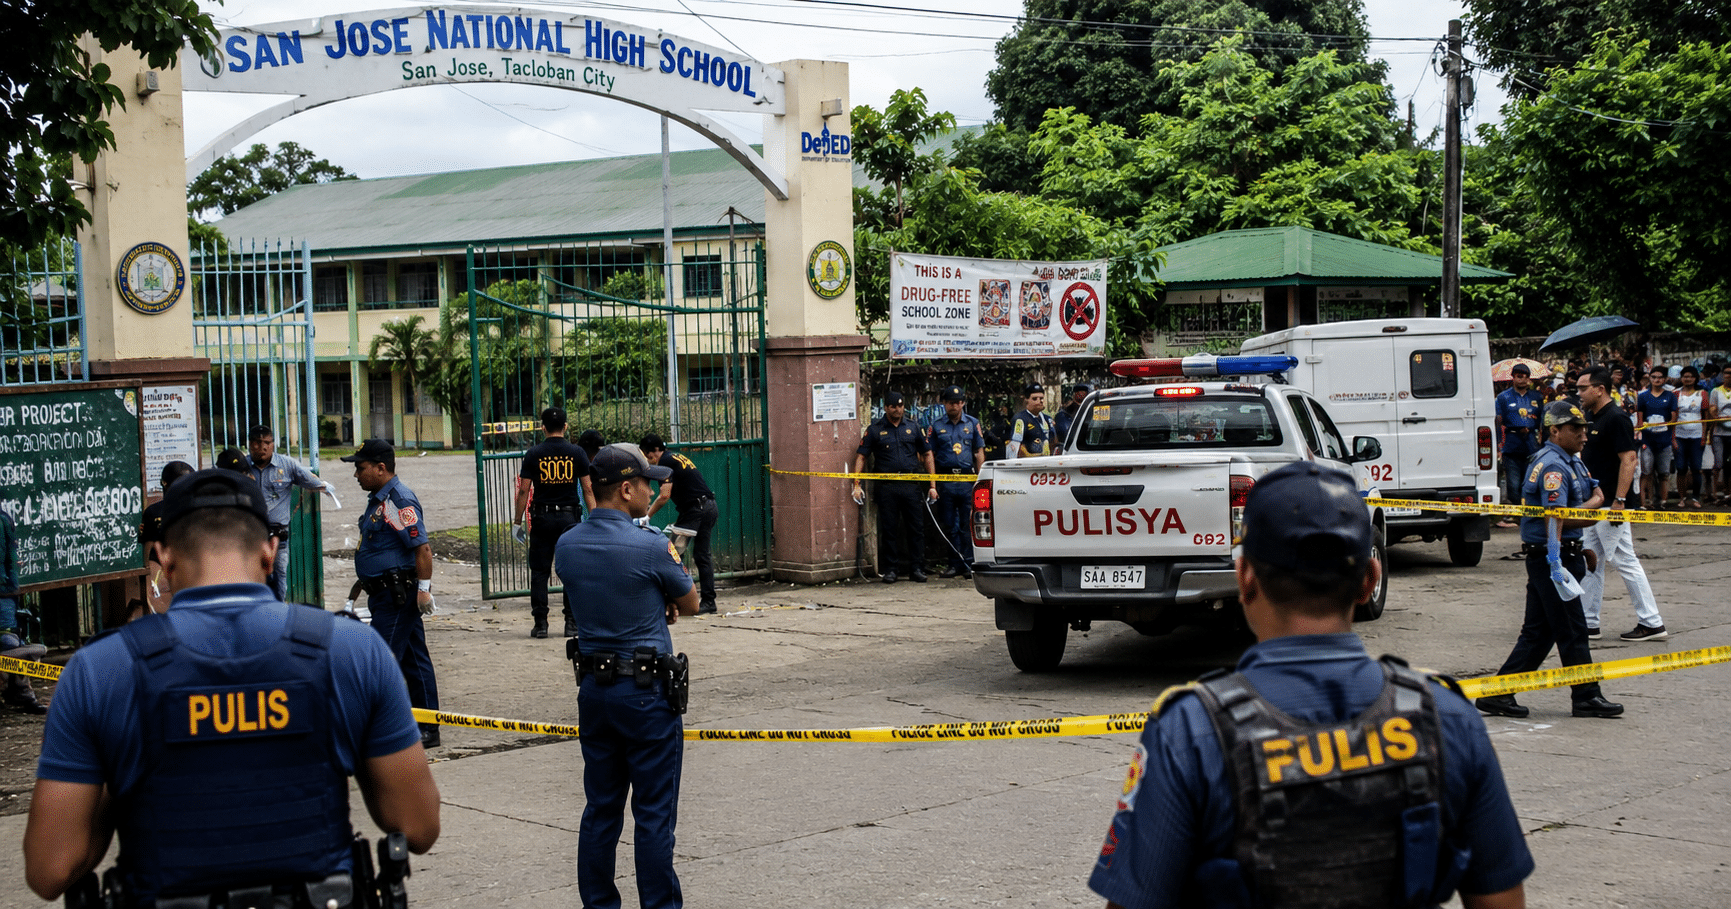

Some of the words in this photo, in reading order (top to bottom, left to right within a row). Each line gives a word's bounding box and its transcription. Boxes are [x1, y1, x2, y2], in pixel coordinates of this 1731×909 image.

[225, 29, 304, 73] SAN
[325, 17, 412, 60] JOSE
[425, 9, 571, 55] NATIONAL
[584, 19, 645, 68] HIGH
[659, 38, 756, 98] SCHOOL
[402, 61, 437, 81] San
[447, 57, 493, 78] Jose,
[502, 57, 575, 81] Tacloban
[583, 66, 616, 92] City
[942, 266, 951, 279] IS
[955, 268, 962, 279] A
[901, 286, 971, 303] DRUG-FREE
[902, 306, 941, 318] SCHOOL
[945, 307, 971, 319] ZONE
[539, 459, 574, 481] SOCO
[1033, 507, 1187, 536] PULISYA
[1084, 571, 1106, 583] SAA
[1112, 571, 1143, 583] 8547
[188, 688, 290, 736] PULIS
